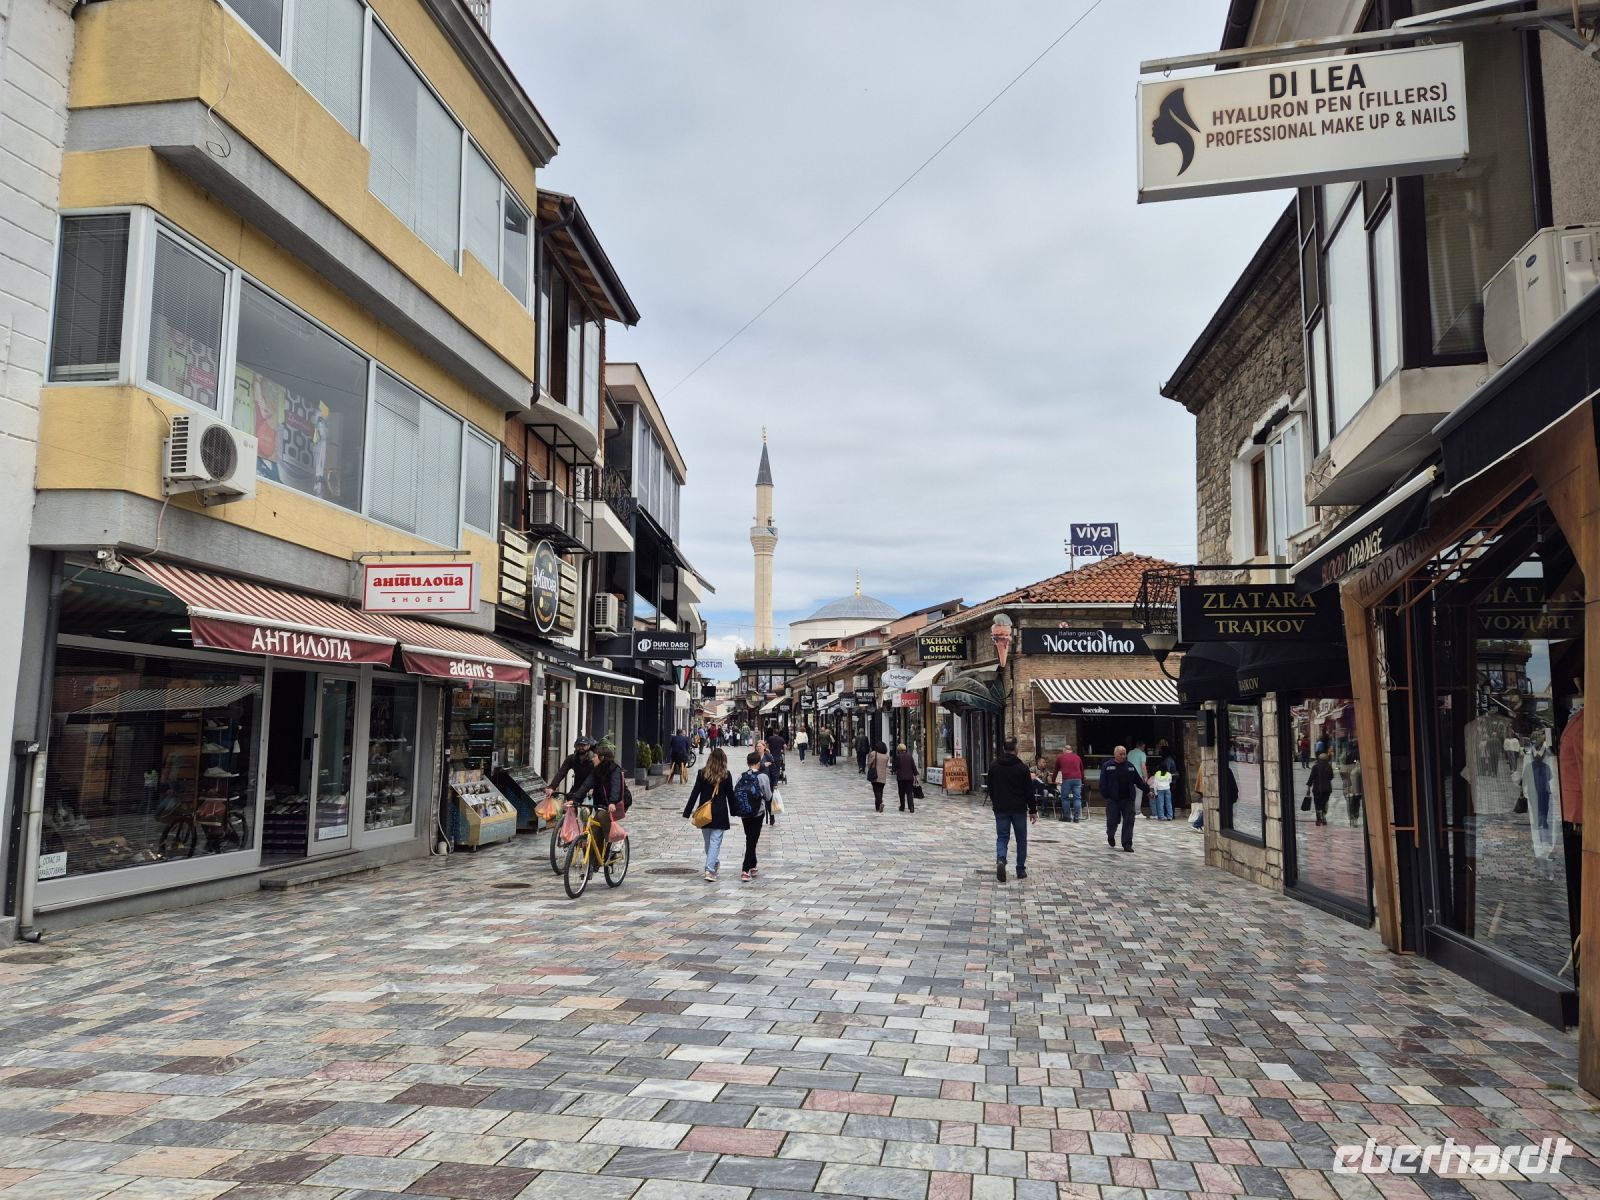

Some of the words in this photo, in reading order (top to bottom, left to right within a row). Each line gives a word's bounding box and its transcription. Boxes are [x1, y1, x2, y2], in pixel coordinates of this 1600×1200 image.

[1269, 71, 1297, 99] DI
[1310, 63, 1367, 95] LEA
[1212, 99, 1308, 127] HYALURON
[1315, 94, 1352, 114] PEN
[1359, 82, 1447, 111] (FILLERS)
[1205, 120, 1317, 148] PROFESSIONAL
[1321, 115, 1365, 135] MAKE
[1369, 112, 1390, 130] UP
[1395, 110, 1406, 127] &
[1411, 105, 1457, 125] NAILS
[1076, 523, 1111, 541] viya
[1072, 540, 1117, 556] travel
[1347, 527, 1384, 572] ORANGE
[1203, 590, 1318, 609] ZLATARA
[1214, 619, 1305, 637] TRAJKOV
[251, 627, 352, 660] АНТИЛОПА
[921, 637, 964, 645] EXCHANGE
[928, 645, 957, 653] OFFICE
[1041, 629, 1135, 653] Nocciolino
[449, 659, 494, 679] adam's
